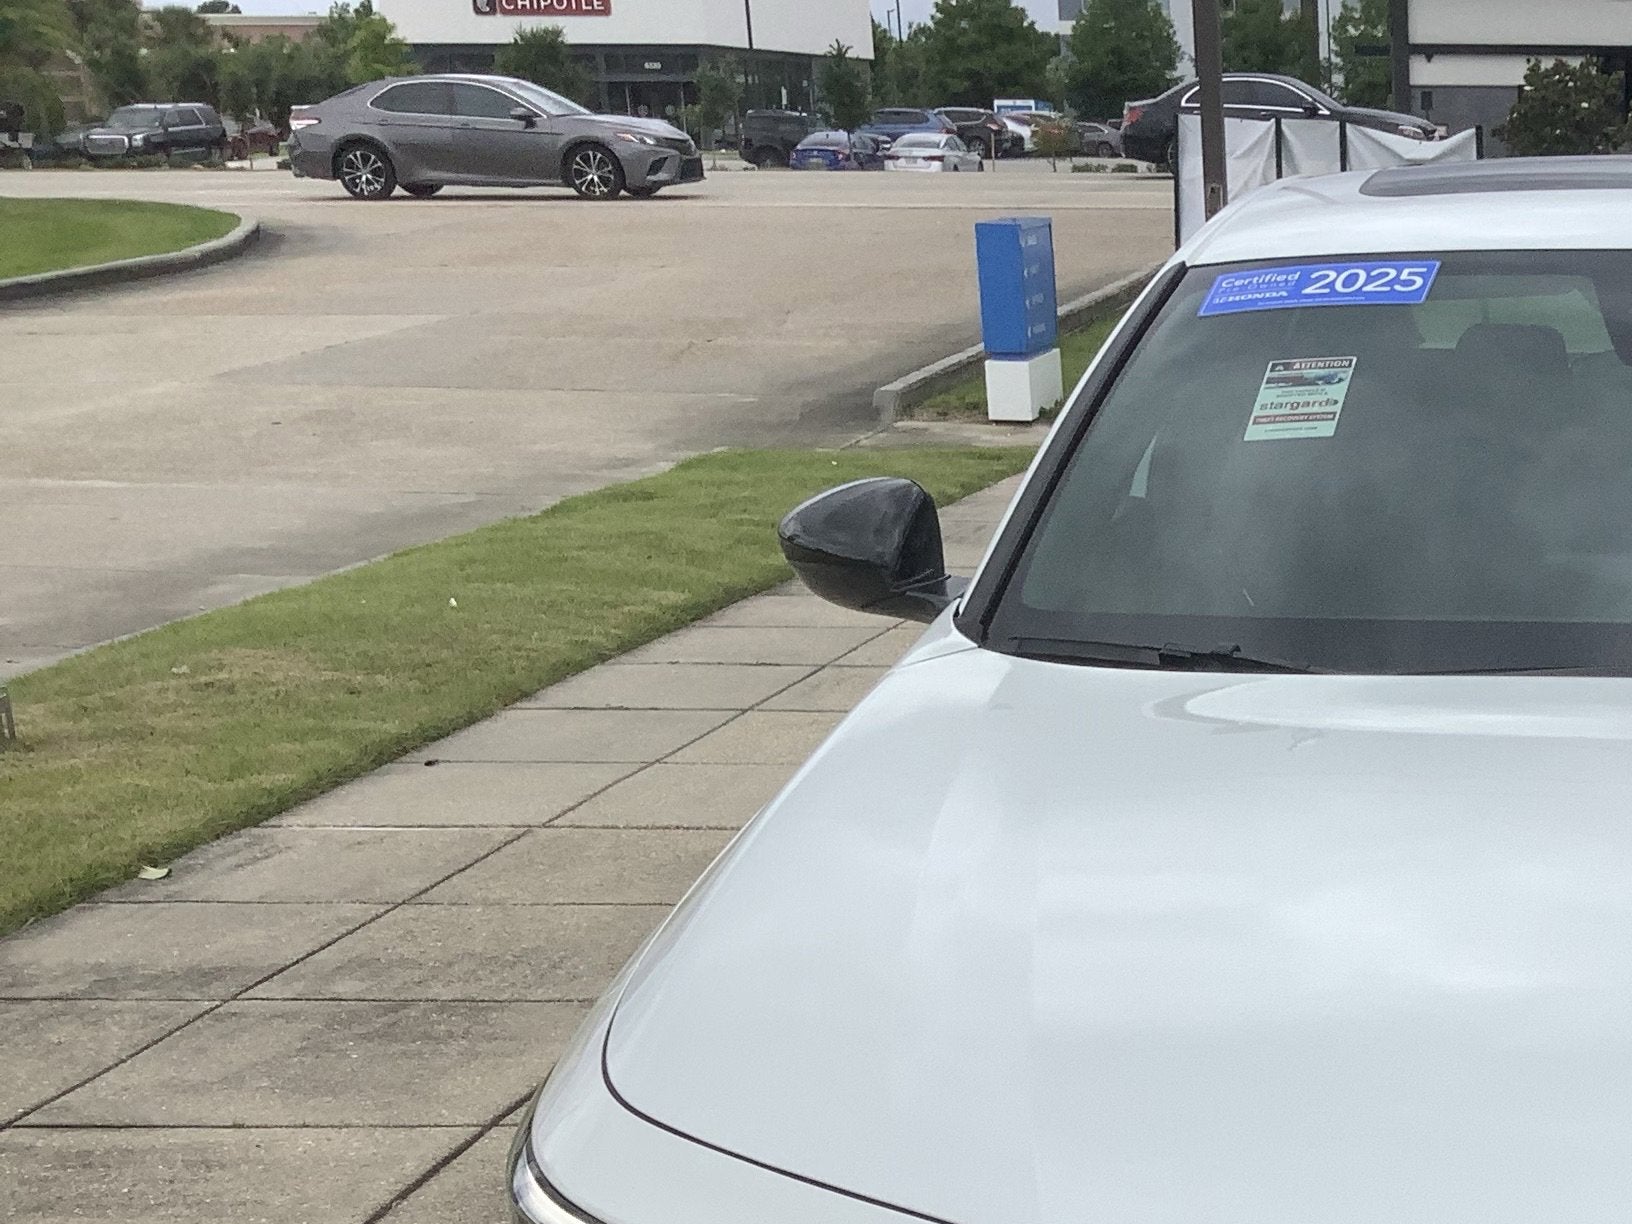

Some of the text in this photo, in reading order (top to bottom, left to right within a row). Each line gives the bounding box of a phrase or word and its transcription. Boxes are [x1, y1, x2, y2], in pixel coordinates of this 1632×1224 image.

[501, 0, 605, 10] CHIPOTLE
[1221, 271, 1301, 288] Certified
[1301, 268, 1427, 294] 2025
[1227, 291, 1288, 302] HONDA
[1293, 359, 1350, 370] ATTENTION
